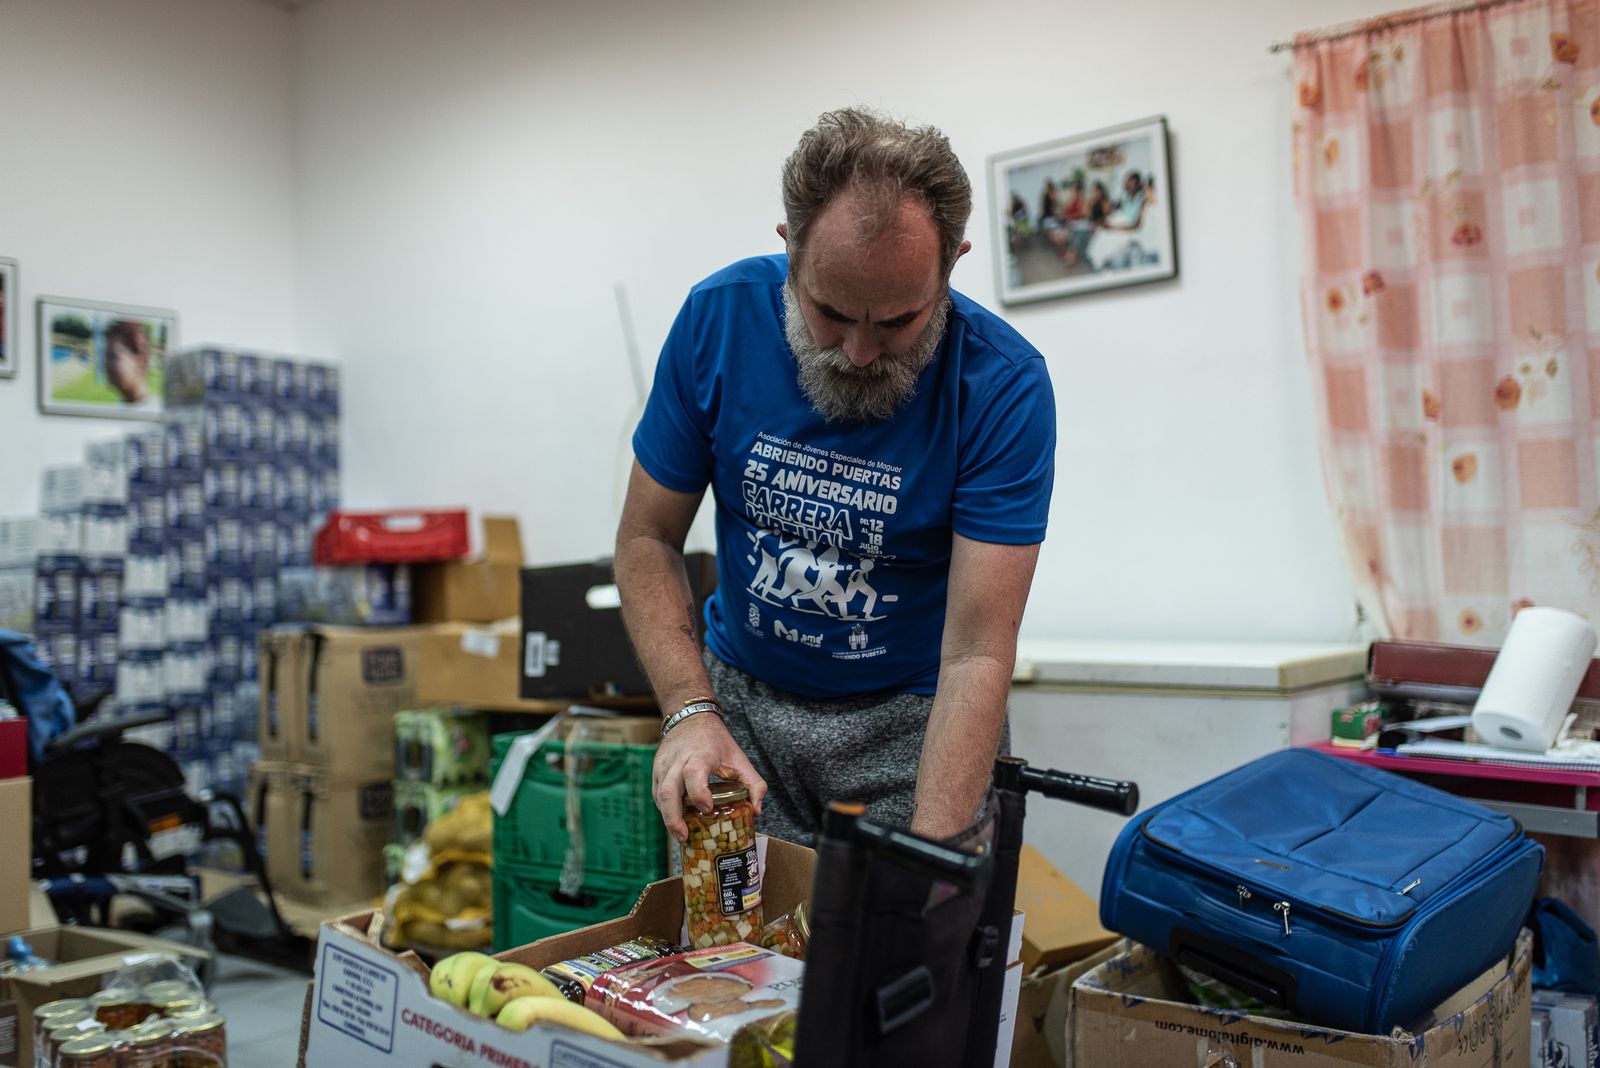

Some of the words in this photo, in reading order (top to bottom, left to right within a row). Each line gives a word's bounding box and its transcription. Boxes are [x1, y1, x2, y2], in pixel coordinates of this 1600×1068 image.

[751, 441, 828, 473] ABRIENDO
[832, 462, 902, 490] PUERTAS
[758, 431, 792, 448] Asociación
[793, 441, 802, 449] de
[803, 443, 829, 457] Jóvenes
[830, 451, 866, 467] Especiales
[867, 459, 876, 468] de
[876, 461, 902, 474] Moguer
[742, 480, 853, 541] CARRERA
[744, 459, 769, 482] 25
[771, 468, 898, 515] ANIVERSARIO
[860, 517, 869, 526] DEL
[869, 518, 884, 533] 12
[868, 532, 883, 547] 18
[400, 1008, 476, 1055] CATEGORIA
[479, 1043, 542, 1068] PRIMER
